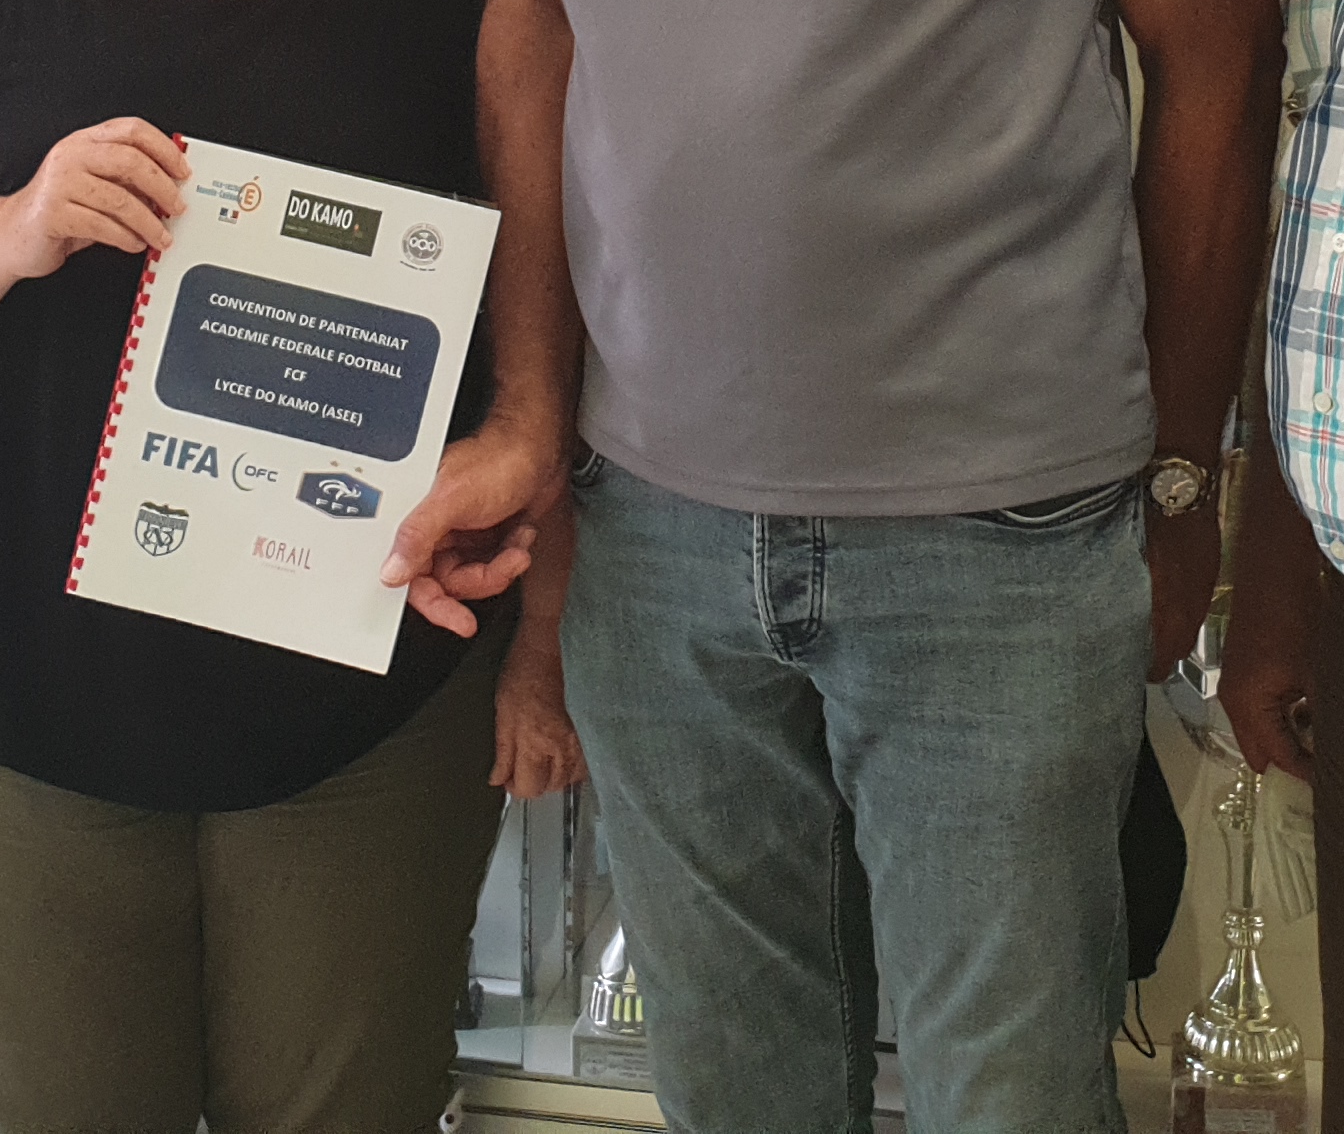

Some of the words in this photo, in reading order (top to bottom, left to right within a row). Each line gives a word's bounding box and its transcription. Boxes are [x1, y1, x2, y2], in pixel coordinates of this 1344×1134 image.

[288, 196, 310, 219] DO
[311, 201, 353, 229] KAMO
[209, 293, 297, 324] CONVENTION
[299, 314, 317, 328] DE
[318, 318, 409, 351] PARTENARIAT
[200, 319, 270, 346] ACADEMIE
[271, 336, 335, 362] FEDERALE
[337, 352, 402, 379] FOOTBALL
[284, 367, 308, 382] FCF
[214, 378, 253, 398] LYCEE
[255, 388, 276, 403] DO
[277, 393, 320, 414] KAMO
[321, 404, 364, 427] (ASEE)
[141, 431, 219, 479] FIFA
[244, 465, 279, 483] OFC
[252, 536, 311, 570] KORAIL
